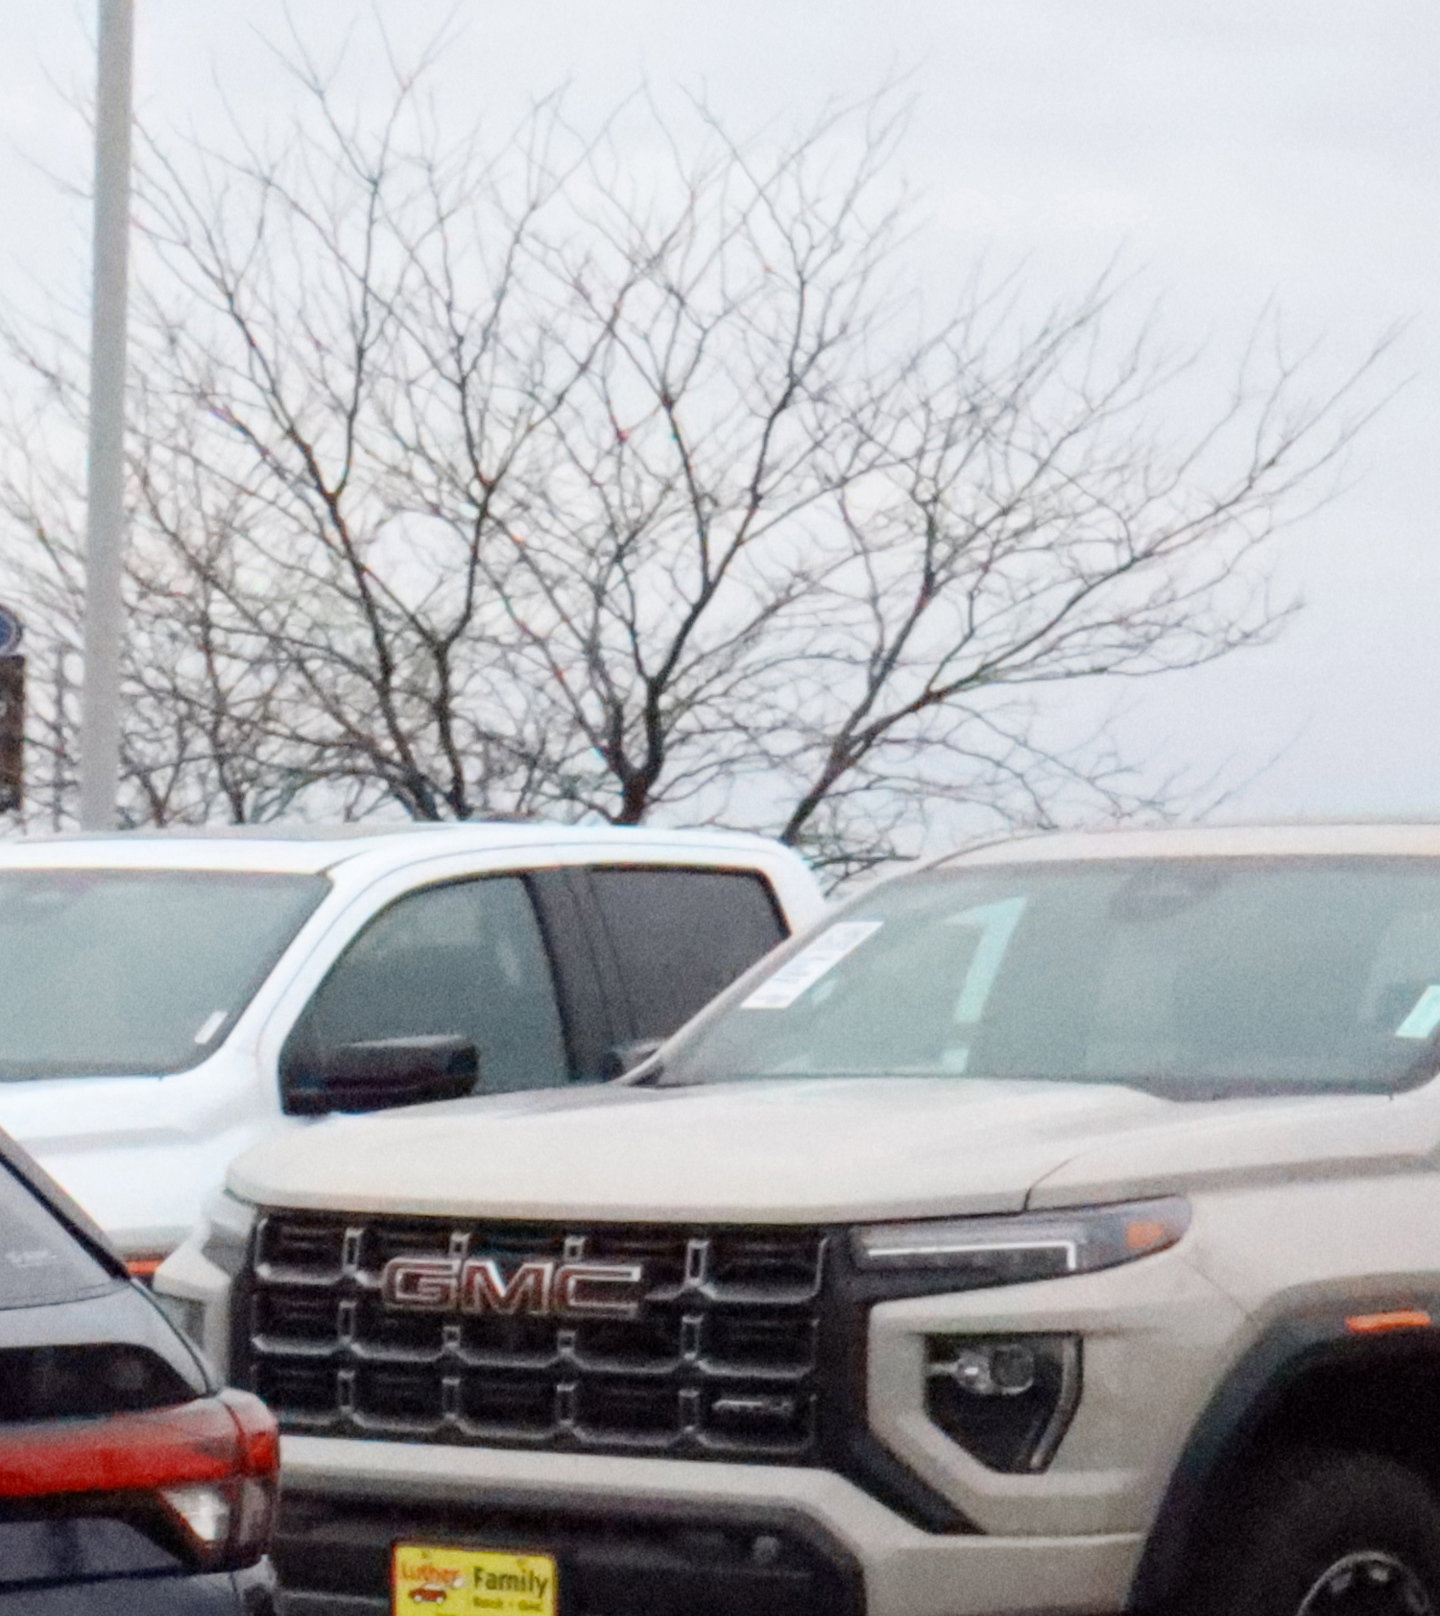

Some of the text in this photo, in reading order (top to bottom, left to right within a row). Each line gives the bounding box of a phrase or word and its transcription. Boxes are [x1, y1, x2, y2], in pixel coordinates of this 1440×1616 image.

[381, 1257, 641, 1318] GMC
[401, 1561, 549, 1598] Luther Family
